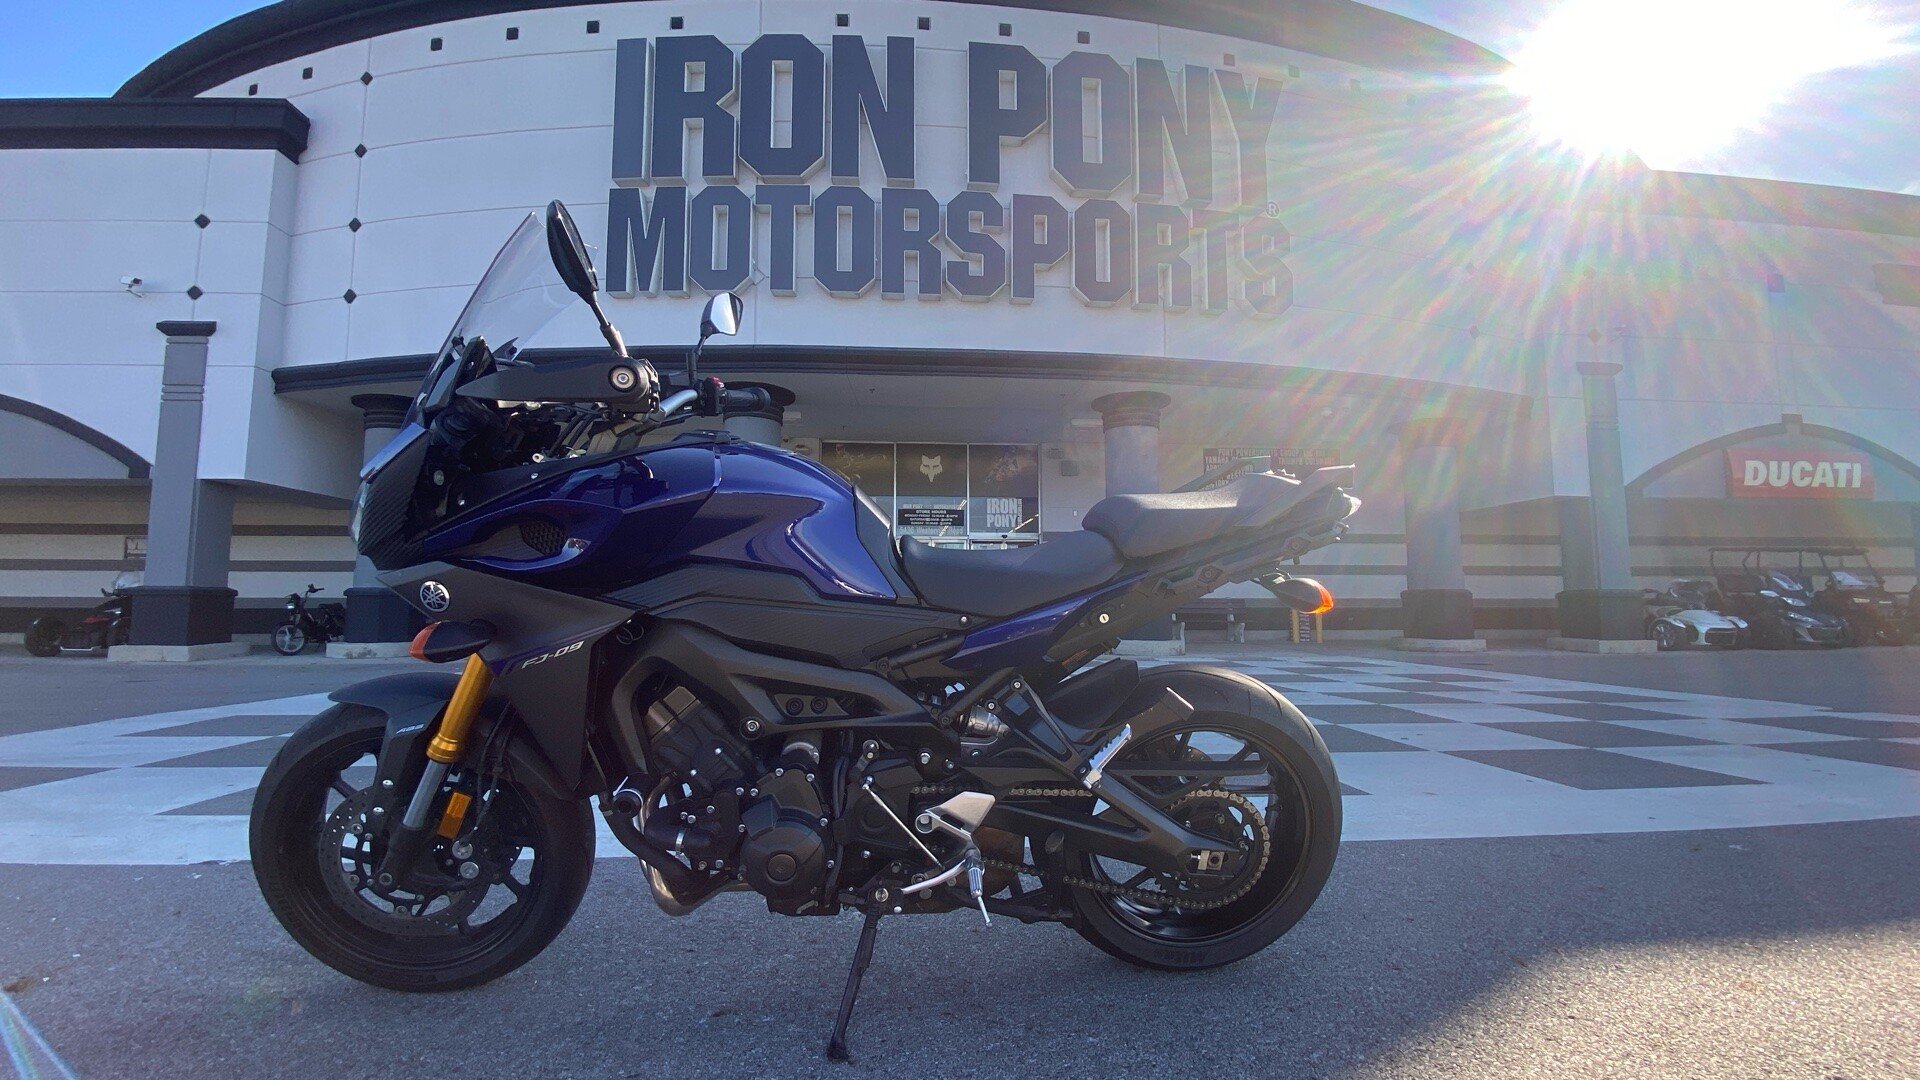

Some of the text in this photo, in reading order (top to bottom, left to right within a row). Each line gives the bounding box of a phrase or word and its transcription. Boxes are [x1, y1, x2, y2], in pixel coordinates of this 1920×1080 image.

[611, 33, 1284, 208] IRON PONY
[605, 184, 1295, 320] MOTORSPORTS
[1743, 460, 1862, 488] DUCATI
[986, 498, 1018, 513] IRON
[986, 514, 1017, 527] PONY
[521, 640, 584, 669] FJ-09
